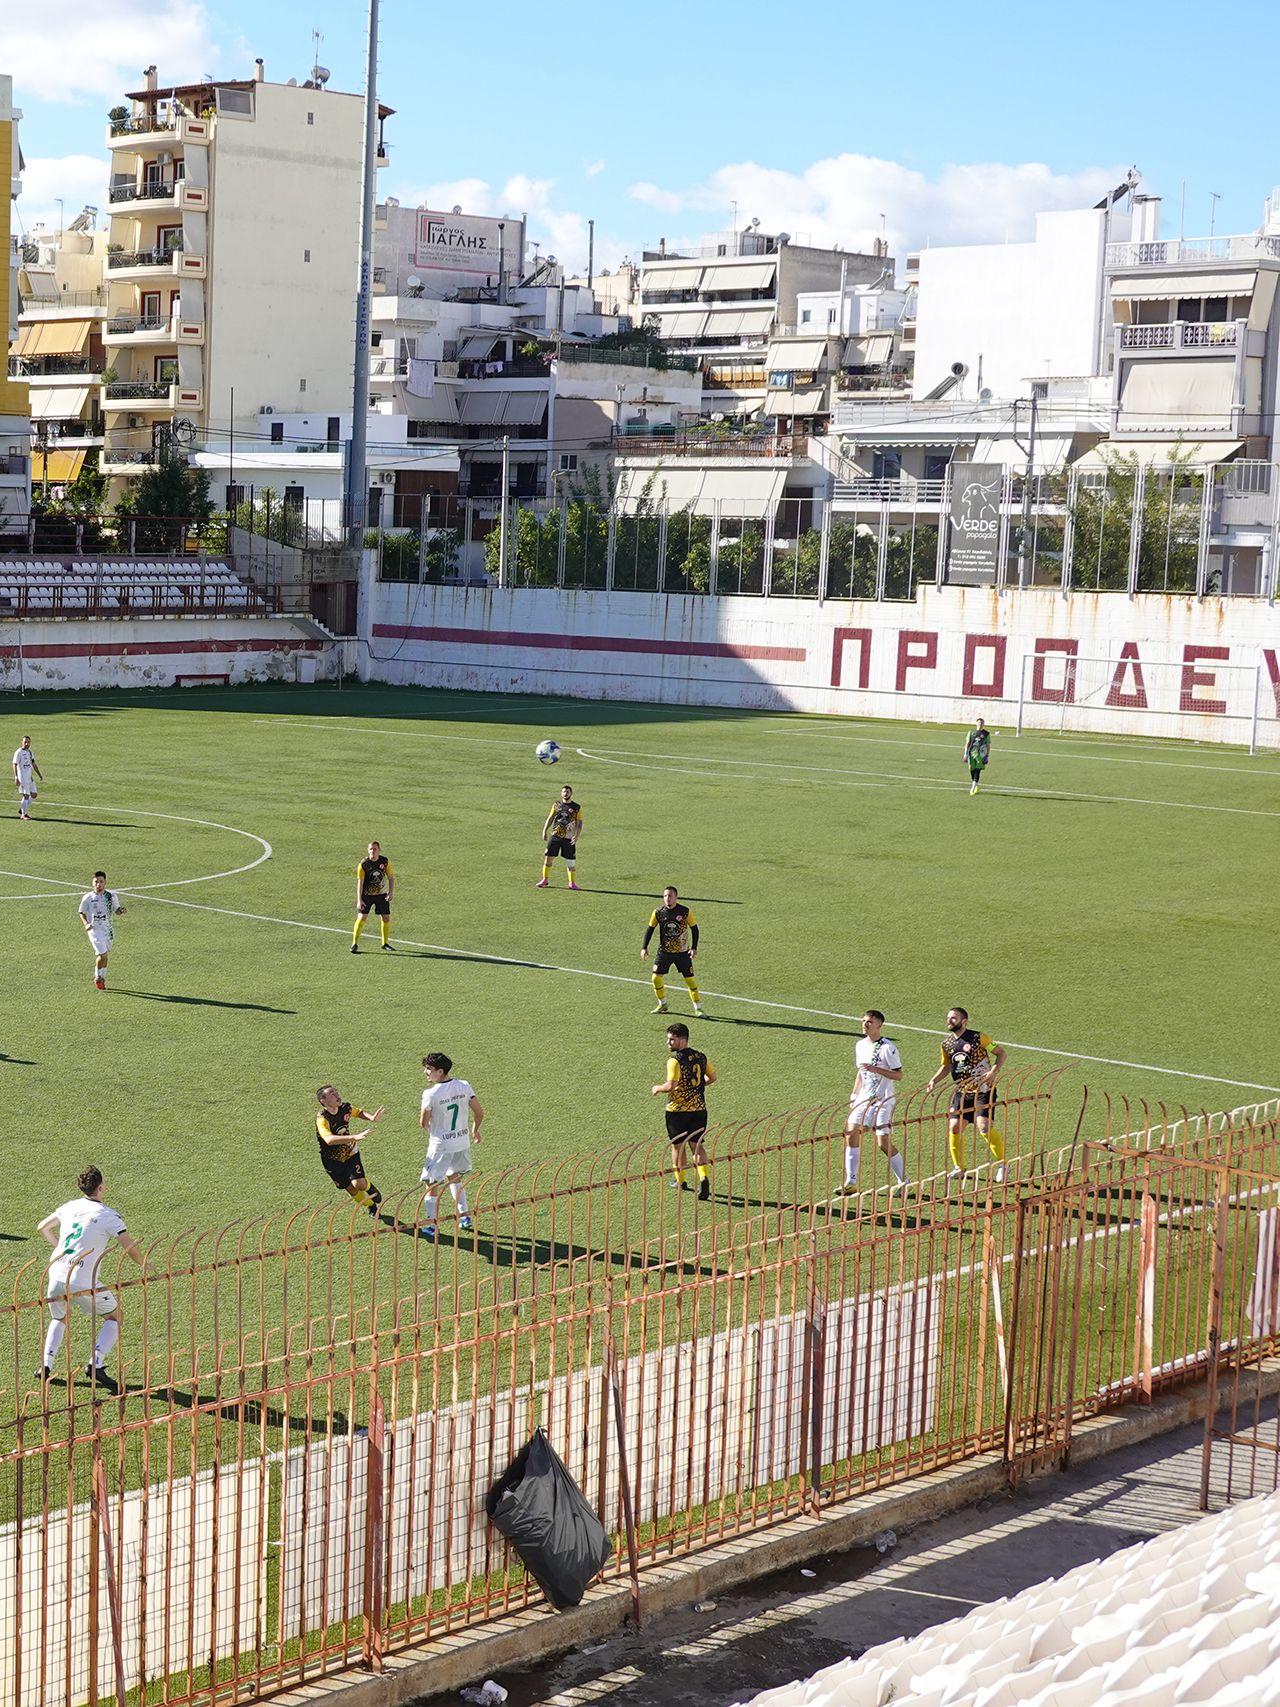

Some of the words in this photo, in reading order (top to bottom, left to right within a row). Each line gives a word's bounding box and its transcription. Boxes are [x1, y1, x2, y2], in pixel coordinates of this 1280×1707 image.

[950, 515, 998, 532] VERDE
[447, 1103, 459, 1131] 7
[355, 1164, 362, 1174] 2
[64, 1222, 83, 1255] 2
